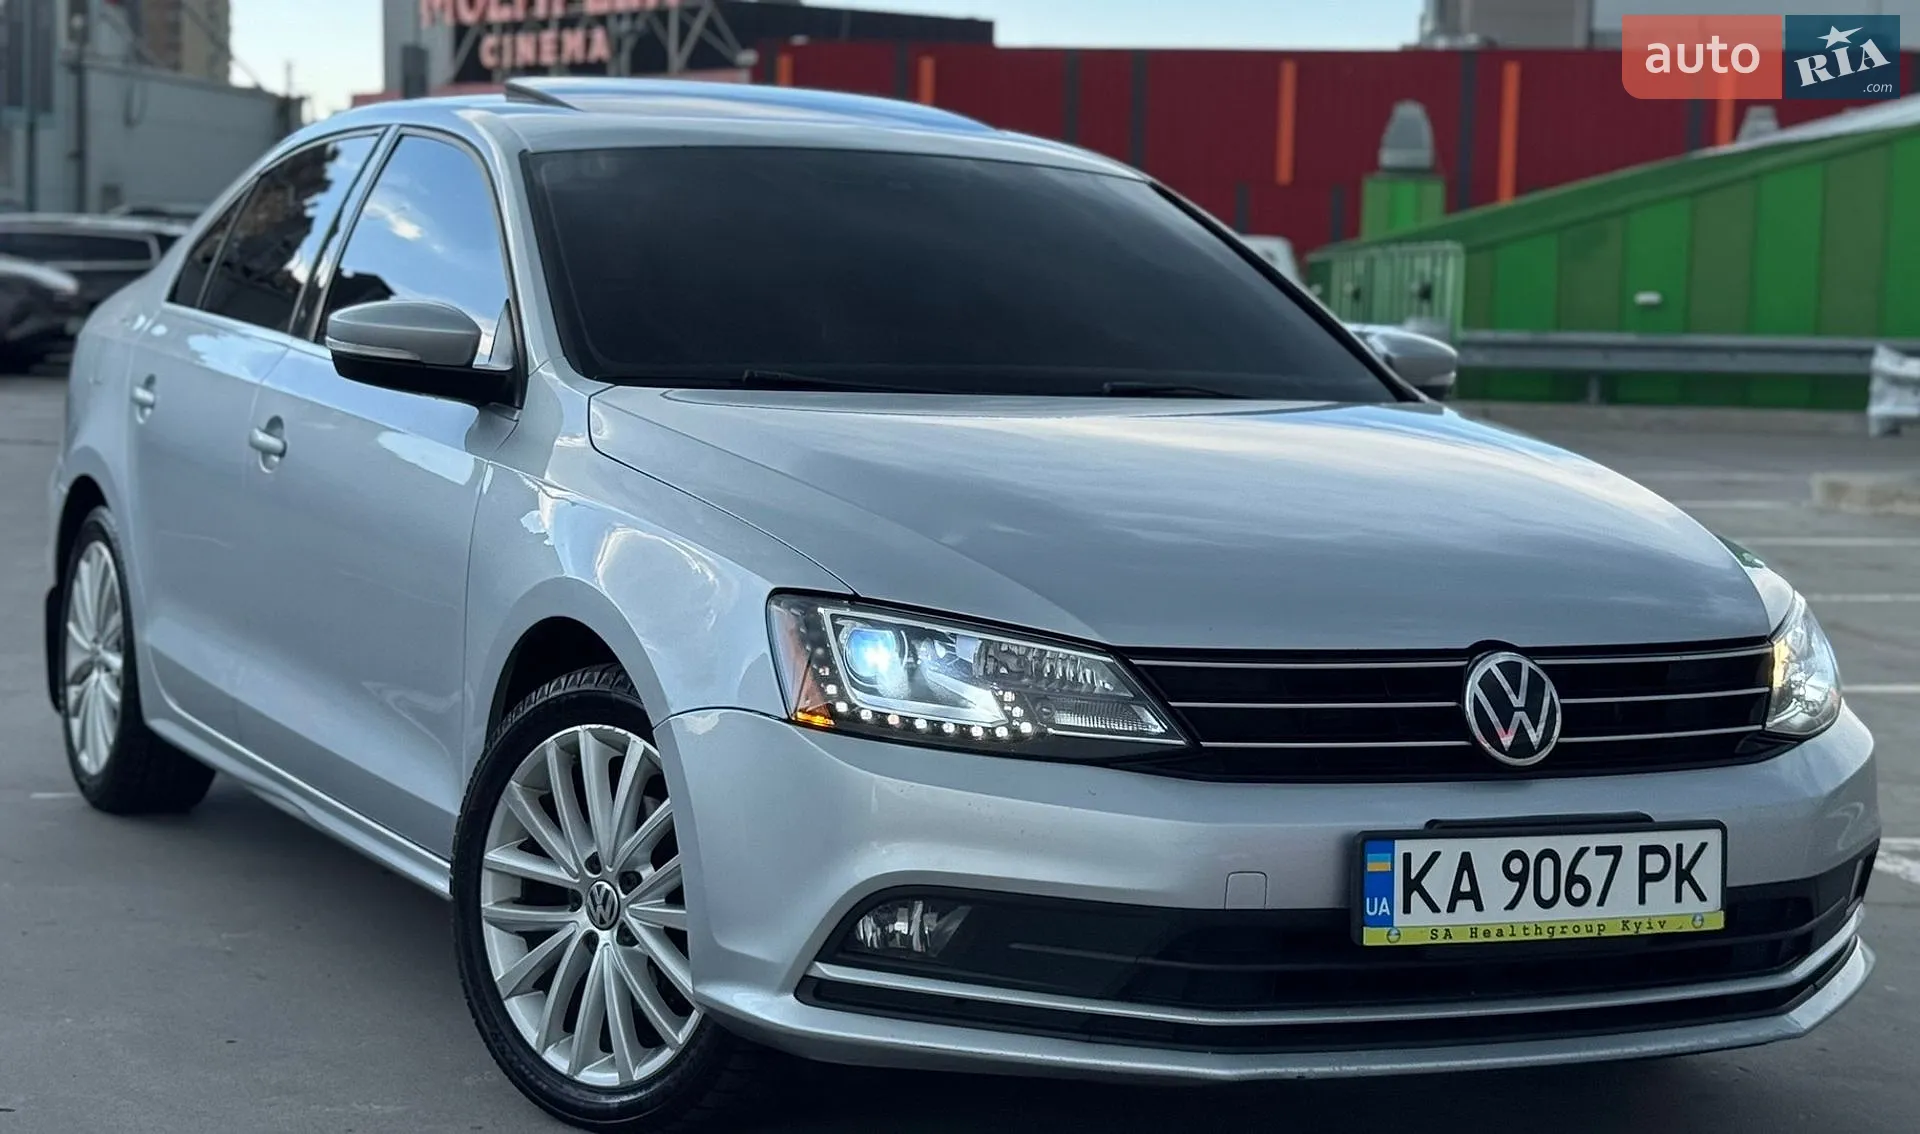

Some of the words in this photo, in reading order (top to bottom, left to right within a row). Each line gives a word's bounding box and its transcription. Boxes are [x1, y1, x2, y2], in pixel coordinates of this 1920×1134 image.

[478, 26, 610, 69] CINEMA
[1402, 850, 1485, 914] KA
[1501, 845, 1623, 911] 9067
[1638, 841, 1708, 906] PK
[1366, 897, 1391, 916] UA
[1430, 928, 1453, 940] SA
[1469, 923, 1606, 939] Healthgroup
[1621, 918, 1667, 935] Kyiv
